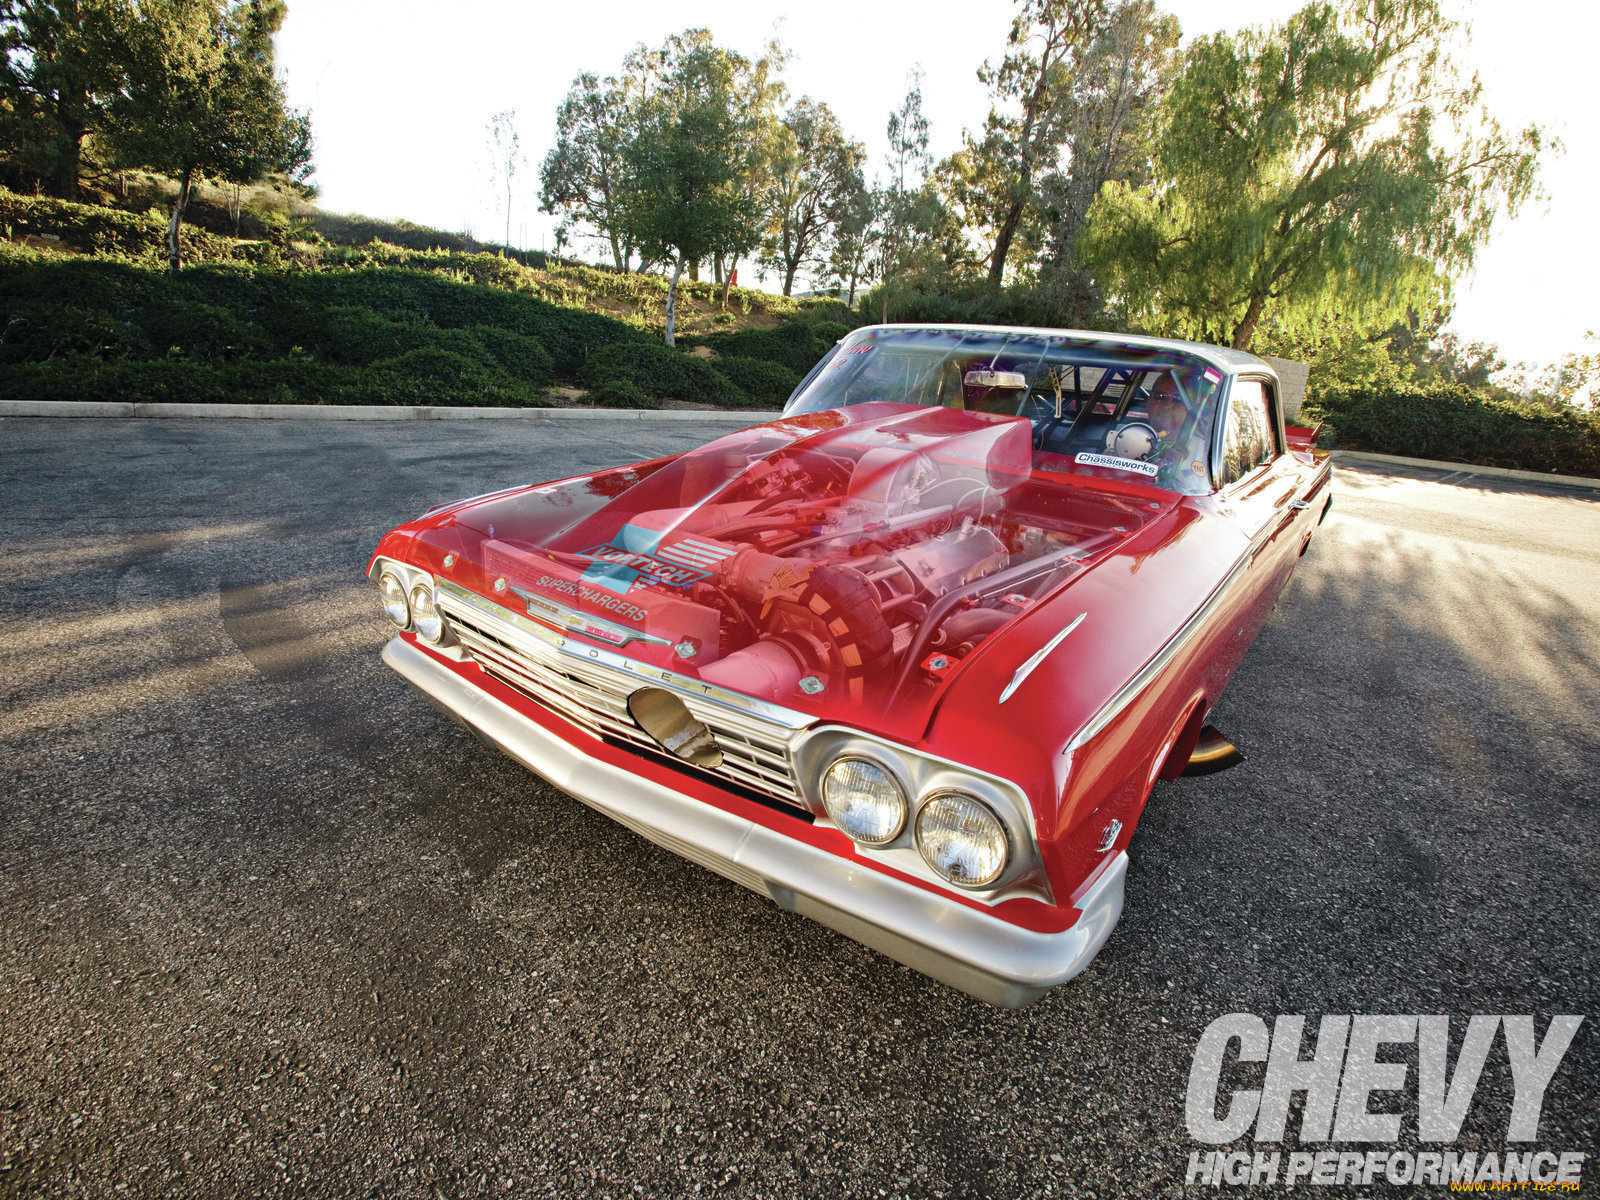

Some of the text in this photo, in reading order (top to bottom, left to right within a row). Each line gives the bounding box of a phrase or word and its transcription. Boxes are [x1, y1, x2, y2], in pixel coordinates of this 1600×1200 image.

[1078, 454, 1155, 474] Chassisworks
[592, 546, 694, 582] VORTECH
[536, 575, 648, 621] SUPERCHARGERS
